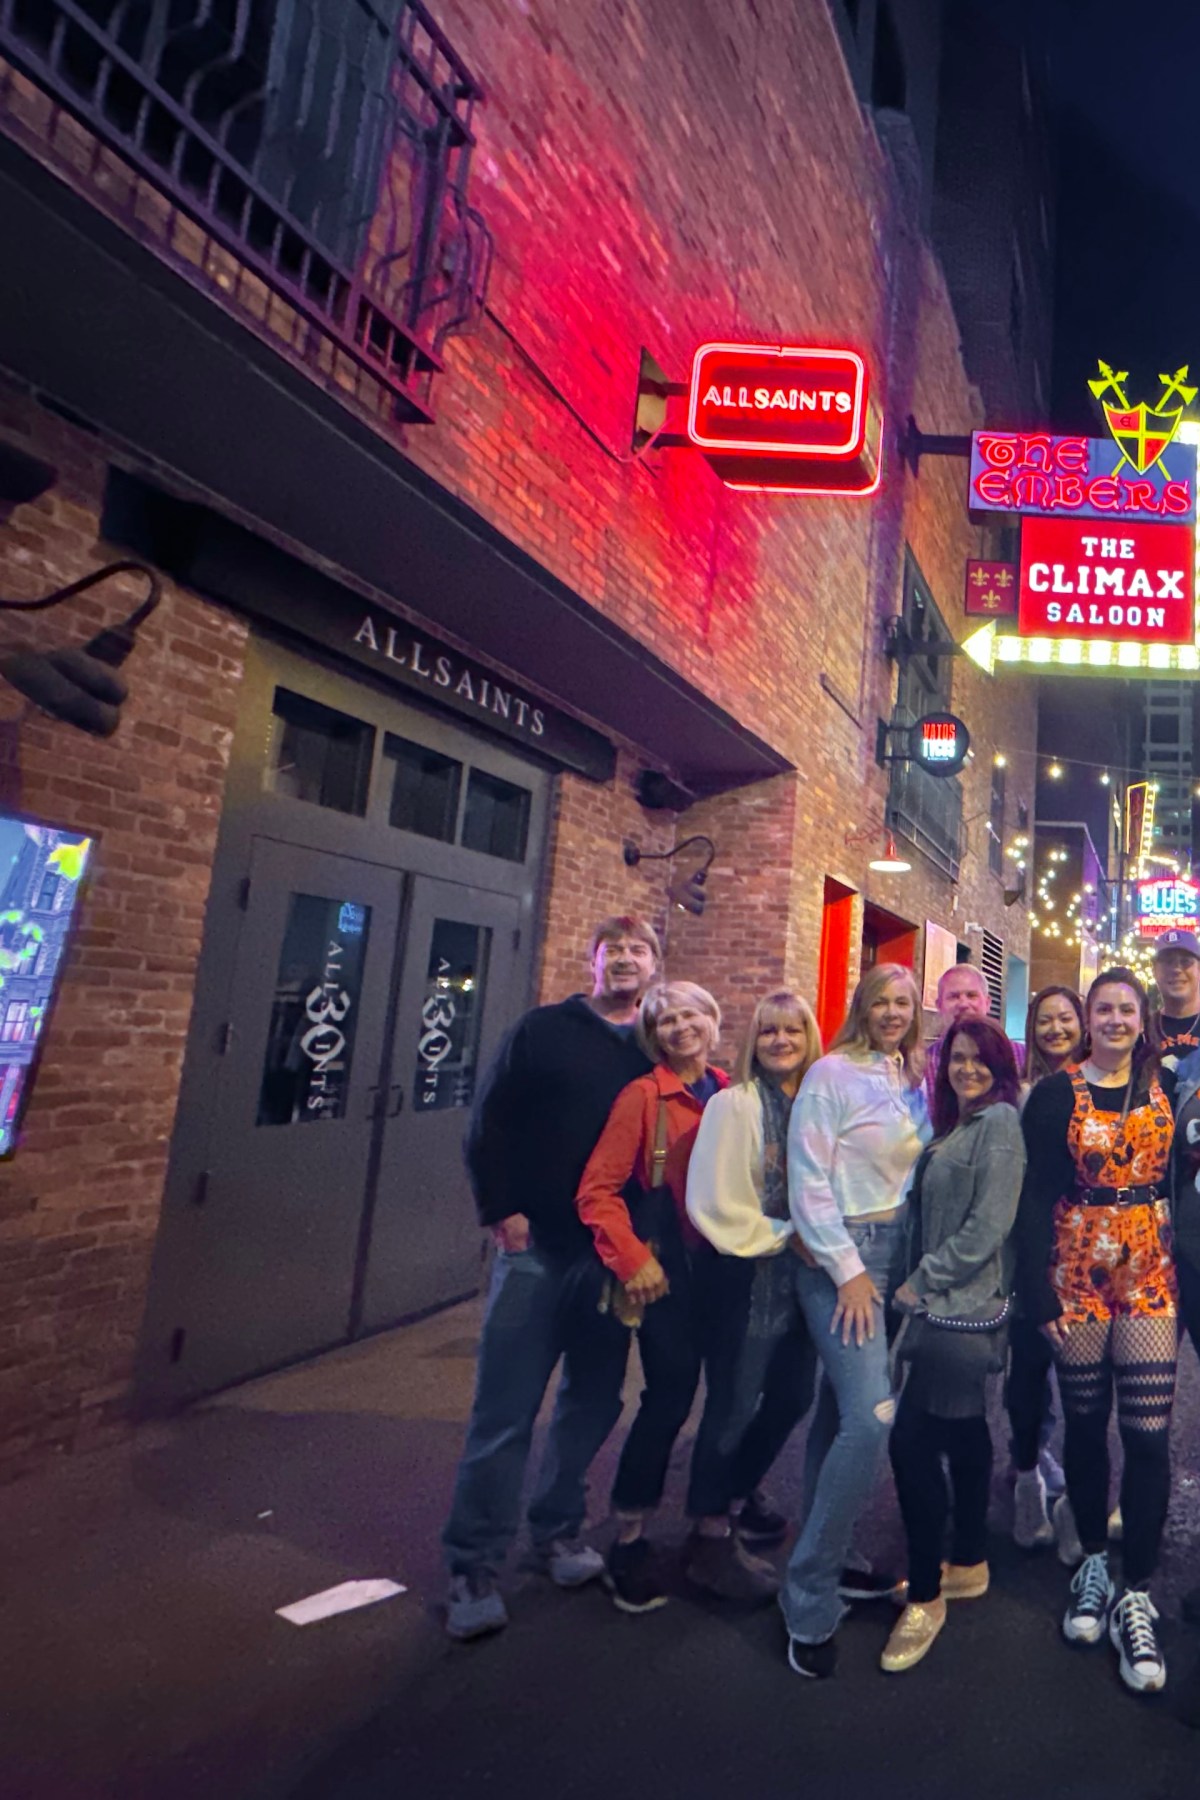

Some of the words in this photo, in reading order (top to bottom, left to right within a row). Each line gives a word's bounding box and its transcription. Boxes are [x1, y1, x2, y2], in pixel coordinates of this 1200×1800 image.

[702, 385, 852, 413] ALLSAINTS
[974, 468, 1192, 516] EMBERS
[1081, 536, 1135, 559] THE
[1029, 562, 1184, 599] CLIMAX
[1047, 602, 1165, 627] SALOON
[354, 616, 545, 736] ALLSAINTS
[923, 723, 956, 740] VATOS
[1140, 887, 1197, 914] BLUES
